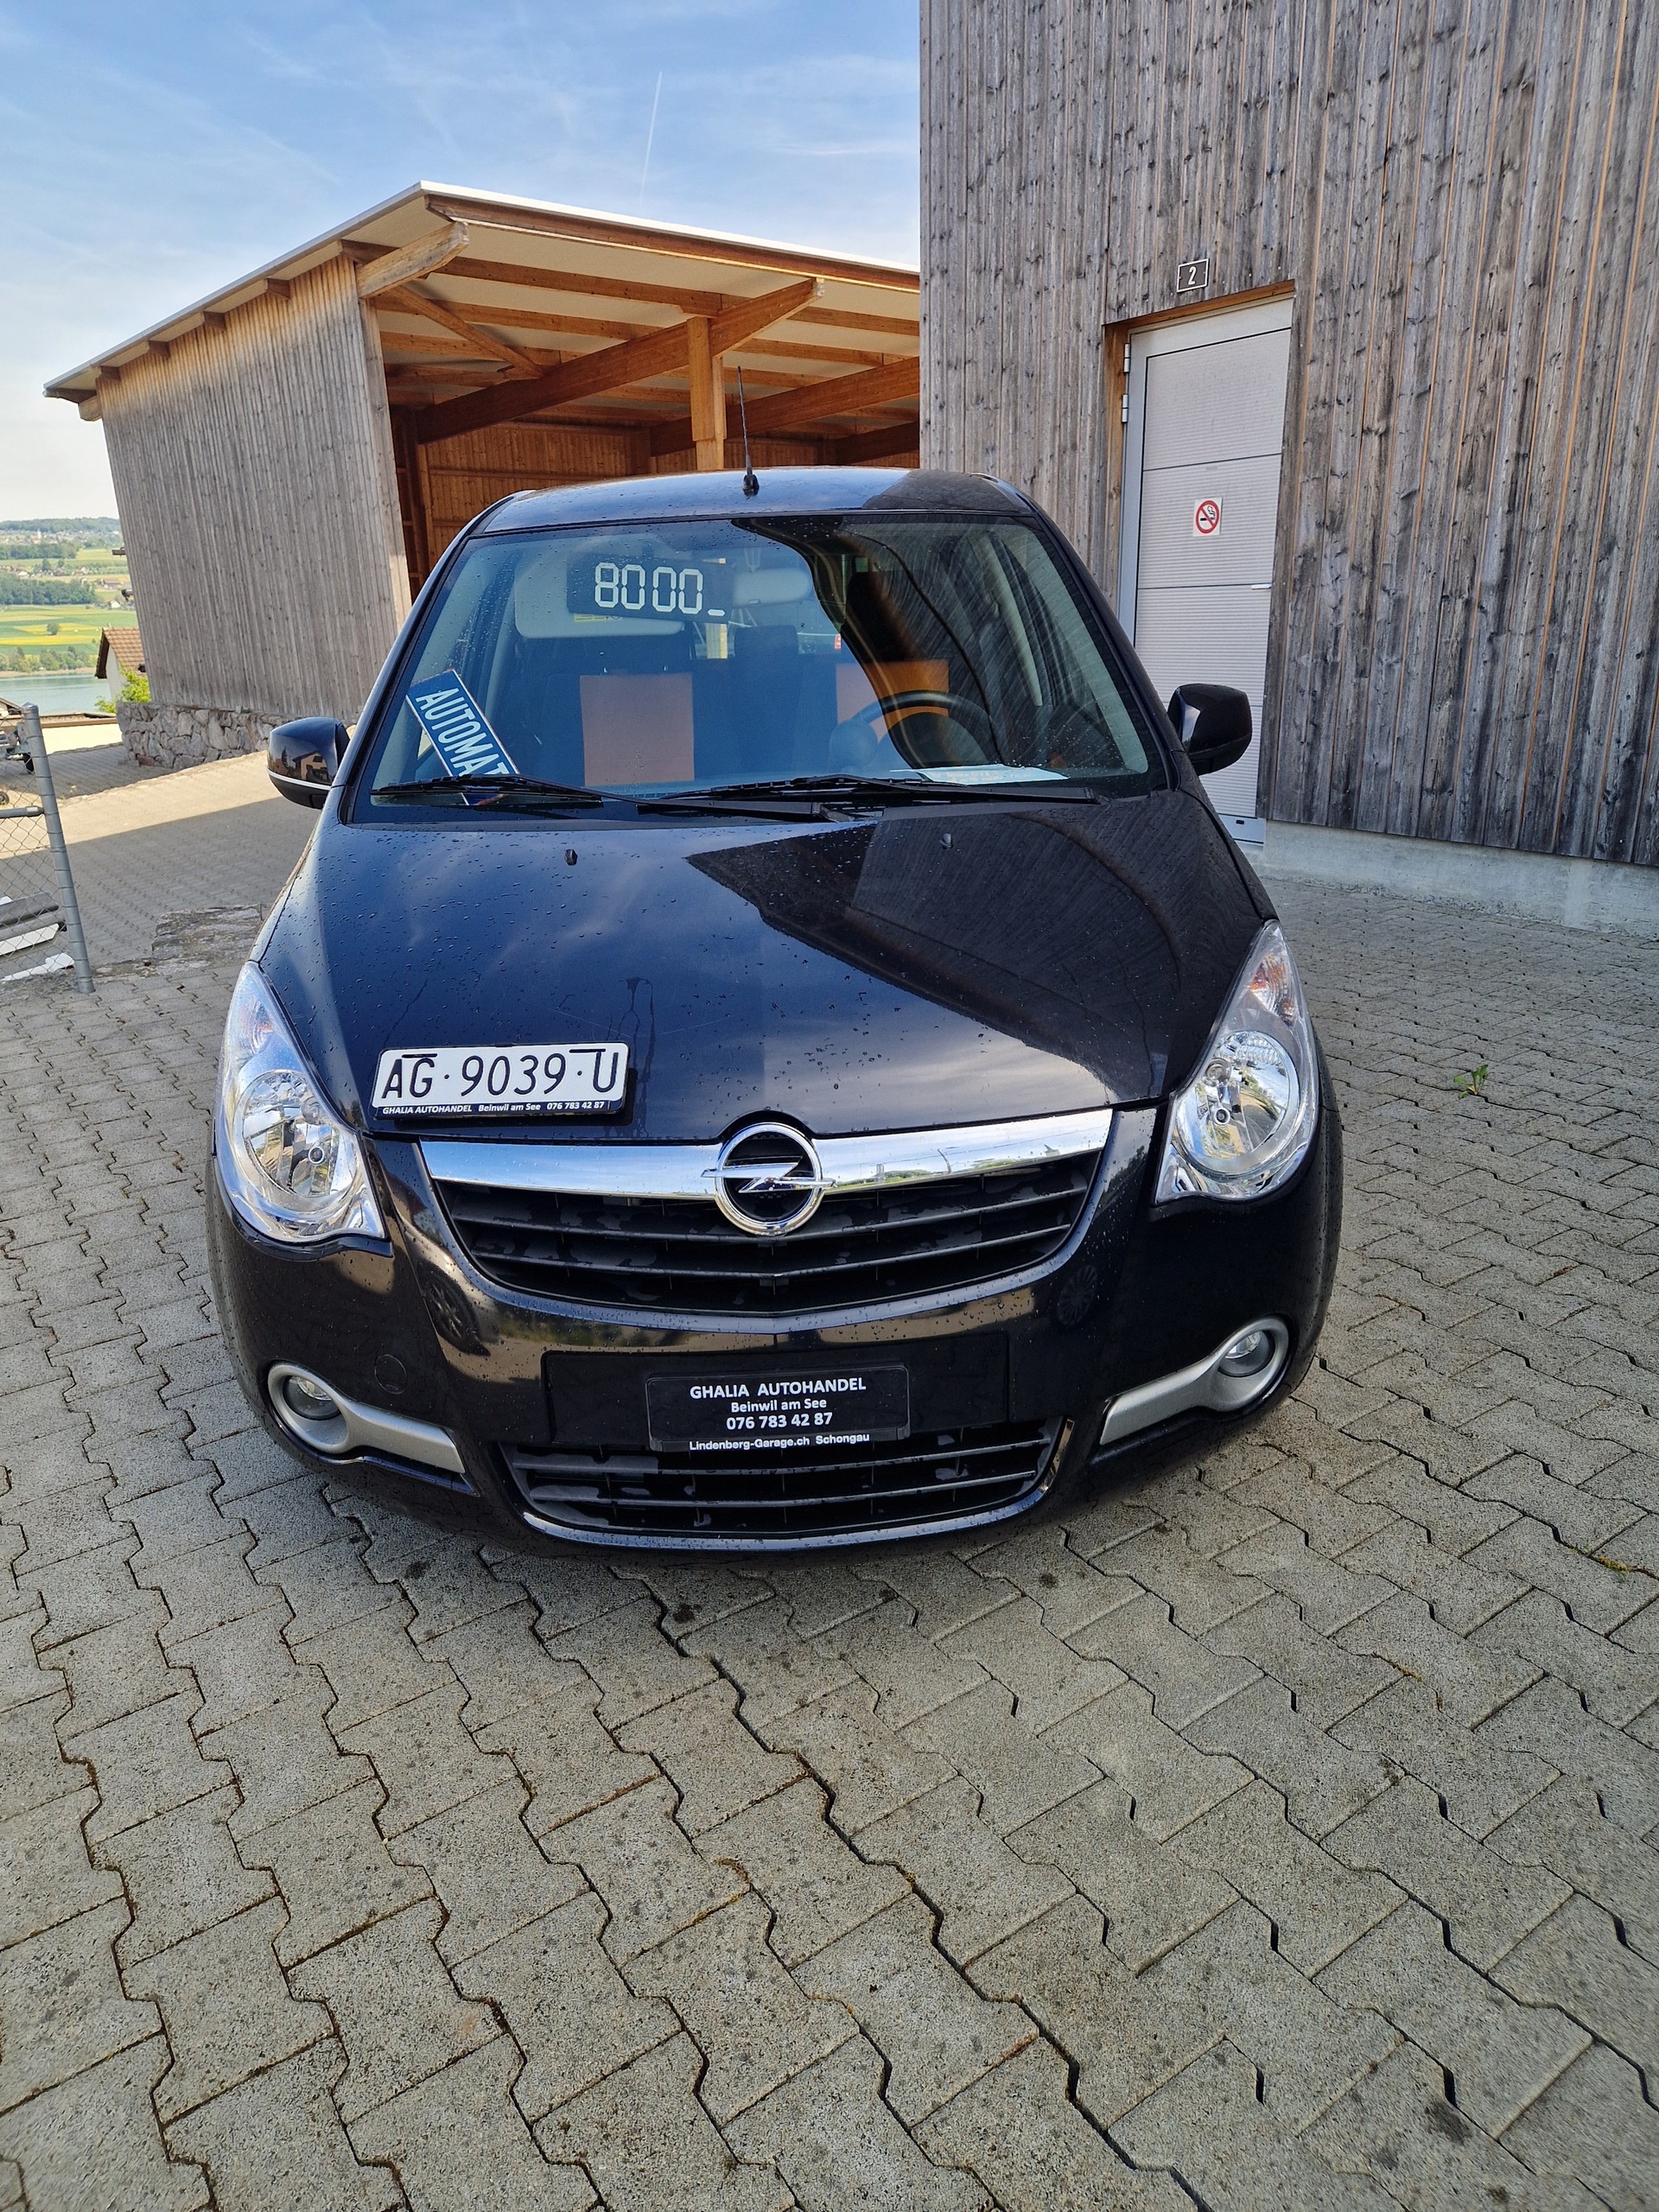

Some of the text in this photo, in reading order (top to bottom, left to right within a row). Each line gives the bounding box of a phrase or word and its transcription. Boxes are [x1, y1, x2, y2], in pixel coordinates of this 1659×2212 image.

[1188, 266, 1197, 285] 2
[415, 1104, 473, 1114] AUTOHANDEL
[478, 1103, 509, 1112] Beinwil
[525, 1103, 541, 1111] See
[546, 1102, 563, 1110] 076
[564, 1102, 580, 1110] 783
[594, 1101, 605, 1109] 87
[690, 1377, 867, 1399] GHALIA AUTOHANDEL
[731, 1398, 827, 1413] Beinwil am See
[726, 1412, 833, 1430] 076 783 42 87
[689, 1433, 870, 1451] Lindenberg-Garage.ch Schongau
